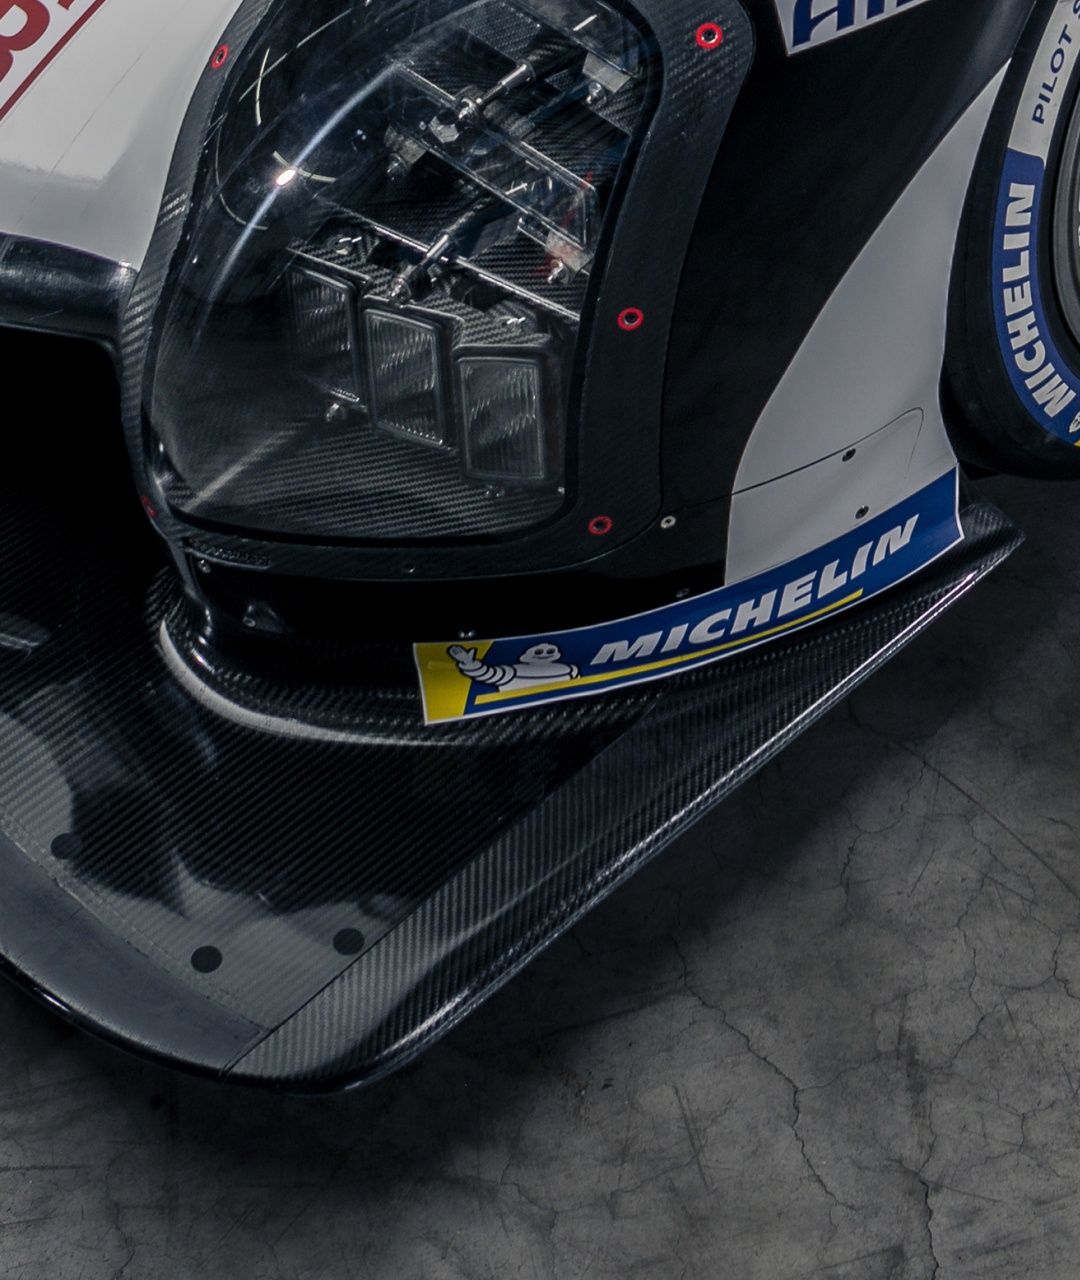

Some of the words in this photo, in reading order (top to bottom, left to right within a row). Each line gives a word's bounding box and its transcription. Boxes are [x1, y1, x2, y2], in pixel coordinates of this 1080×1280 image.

[1032, 24, 1073, 125] PILOT
[1002, 182, 1076, 418] MICHELIN
[590, 514, 920, 665] MICHELIN
